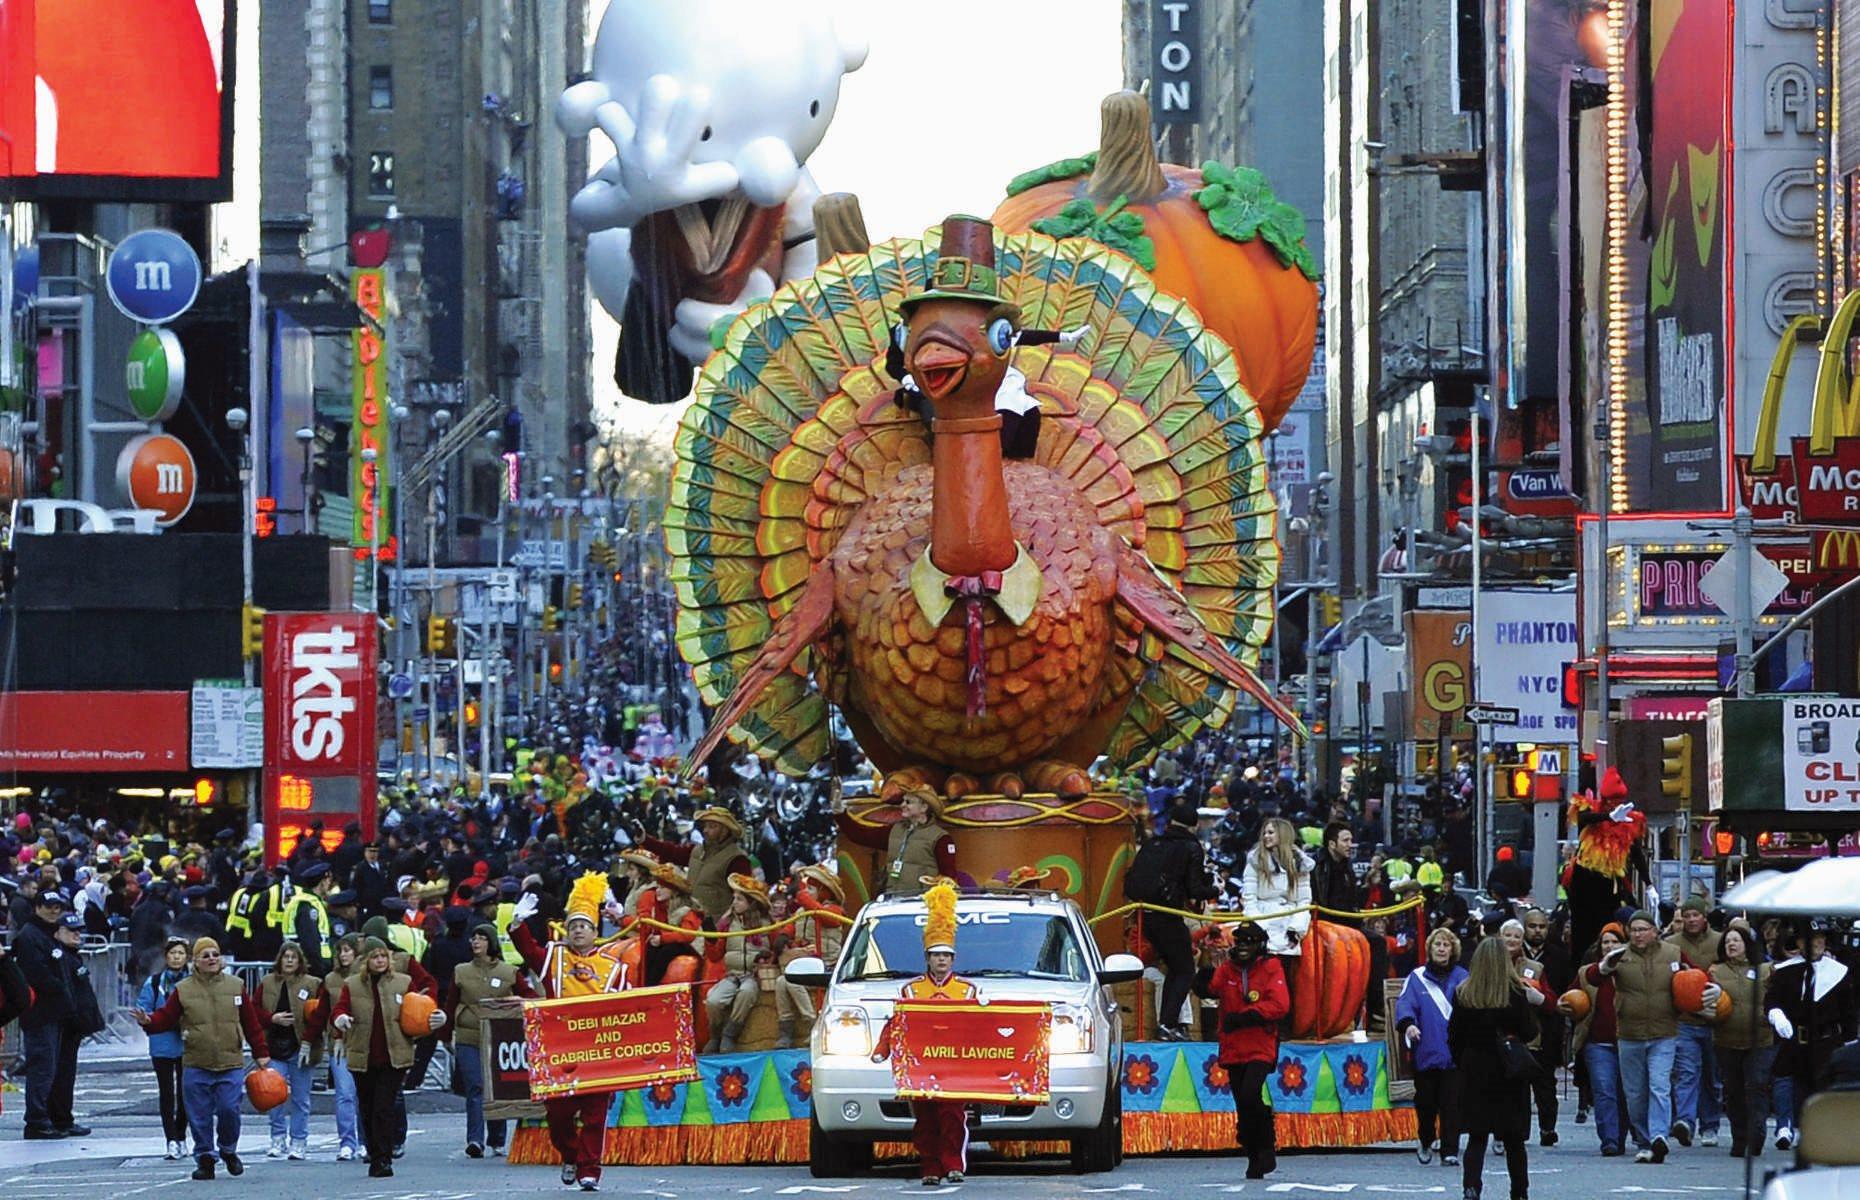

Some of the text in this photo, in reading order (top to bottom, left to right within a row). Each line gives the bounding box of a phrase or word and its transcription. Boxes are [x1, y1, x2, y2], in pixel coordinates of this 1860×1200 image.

[1161, 3, 1192, 111] TON
[134, 261, 172, 290] m
[127, 360, 145, 390] m
[156, 463, 183, 493] m
[1519, 474, 1547, 491] Van
[292, 625, 360, 761] tkts
[1423, 660, 1466, 712] G
[1518, 675, 1558, 693] NYC
[1805, 790, 1839, 803] UP
[567, 1012, 646, 1031] DEBI MAZAR
[595, 1031, 621, 1044] AND
[550, 1041, 671, 1065] GABRIELE CORCOS
[922, 1046, 1015, 1059] AVRIL LAVIGNE
